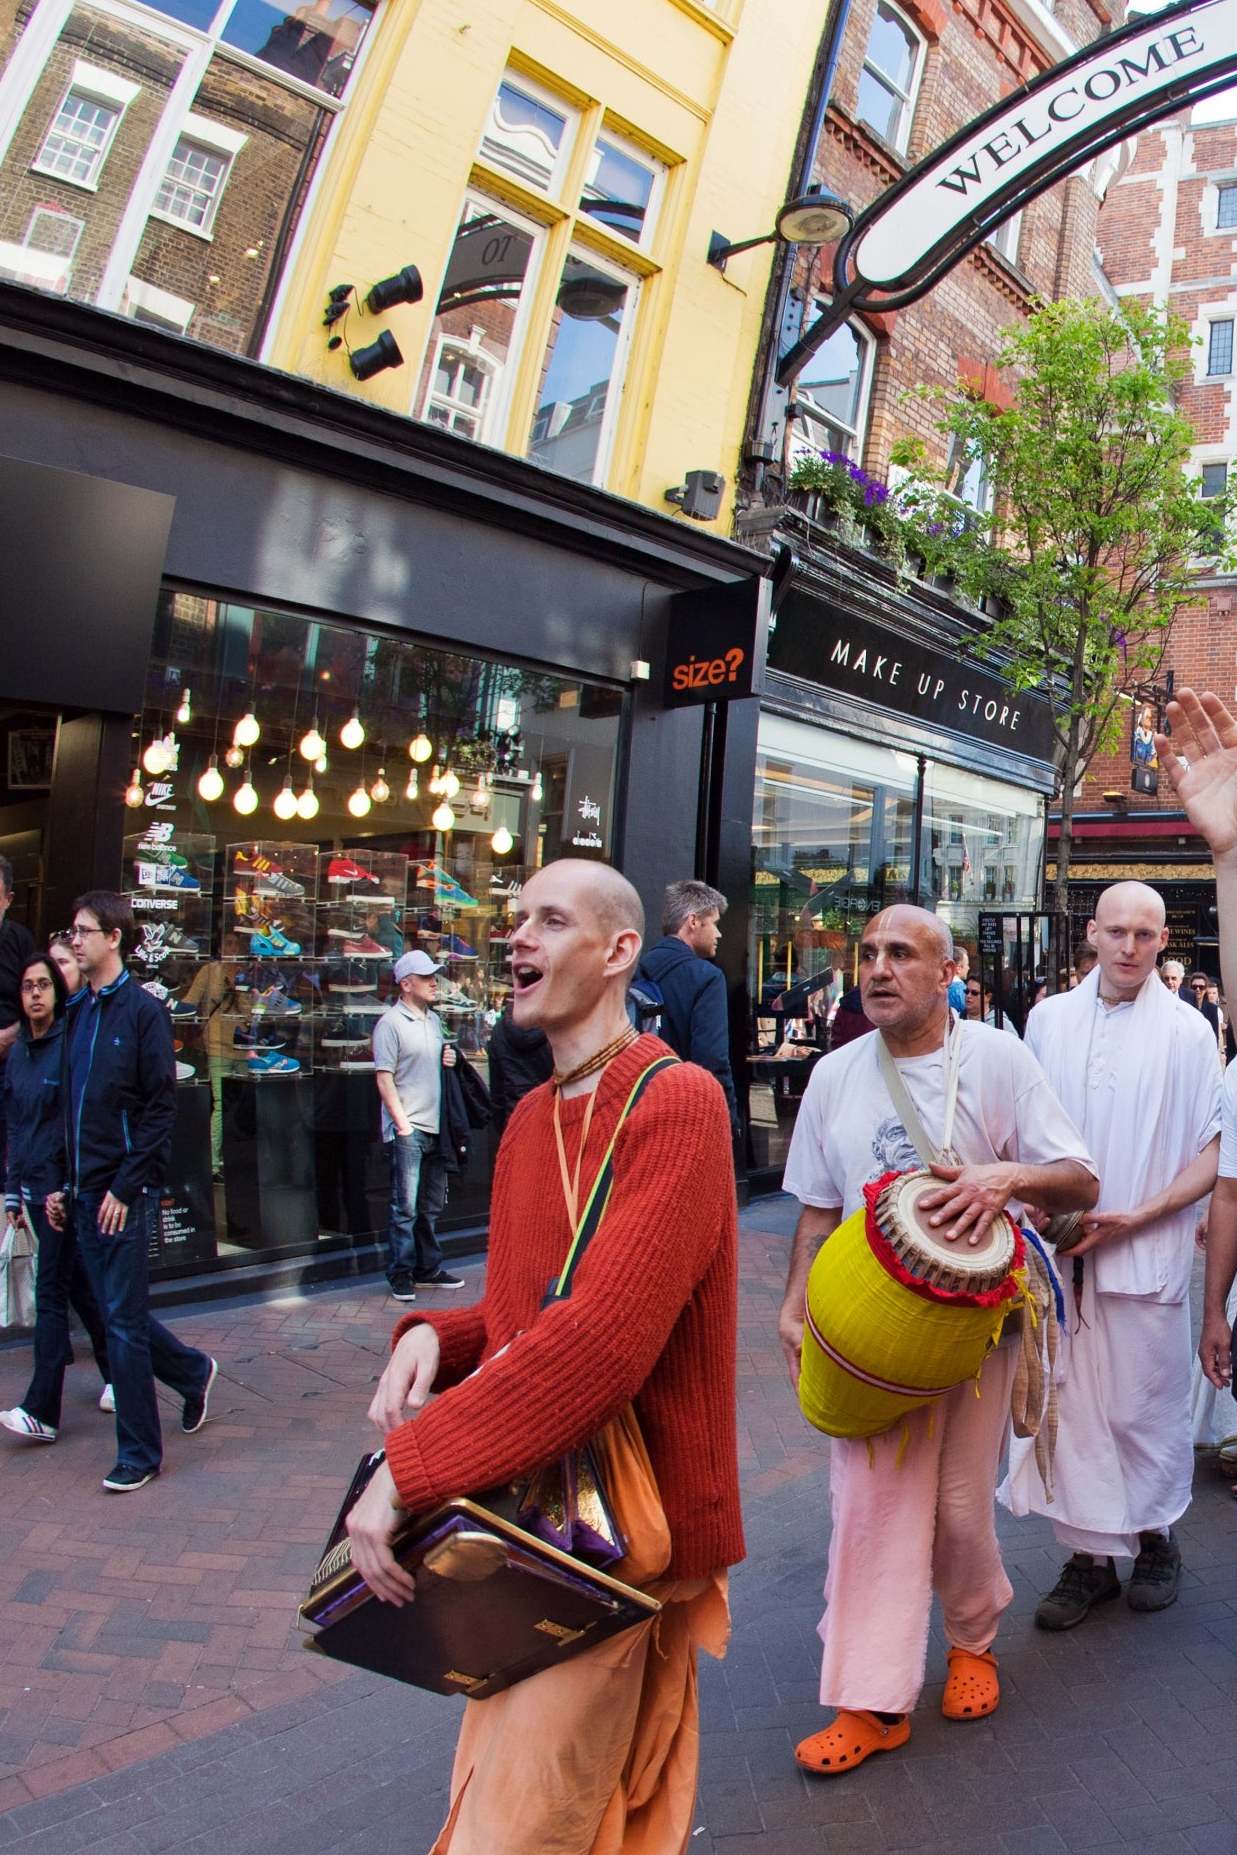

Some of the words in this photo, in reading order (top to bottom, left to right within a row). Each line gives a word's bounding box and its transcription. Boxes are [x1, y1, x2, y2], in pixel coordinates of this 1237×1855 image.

[936, 26, 1205, 197] WELCOME
[672, 647, 745, 691] size?
[830, 639, 903, 686] MAKE
[917, 672, 946, 701] UP
[958, 689, 1021, 731] STORE
[151, 783, 174, 796] NIKE
[131, 899, 178, 910] CONVERSE
